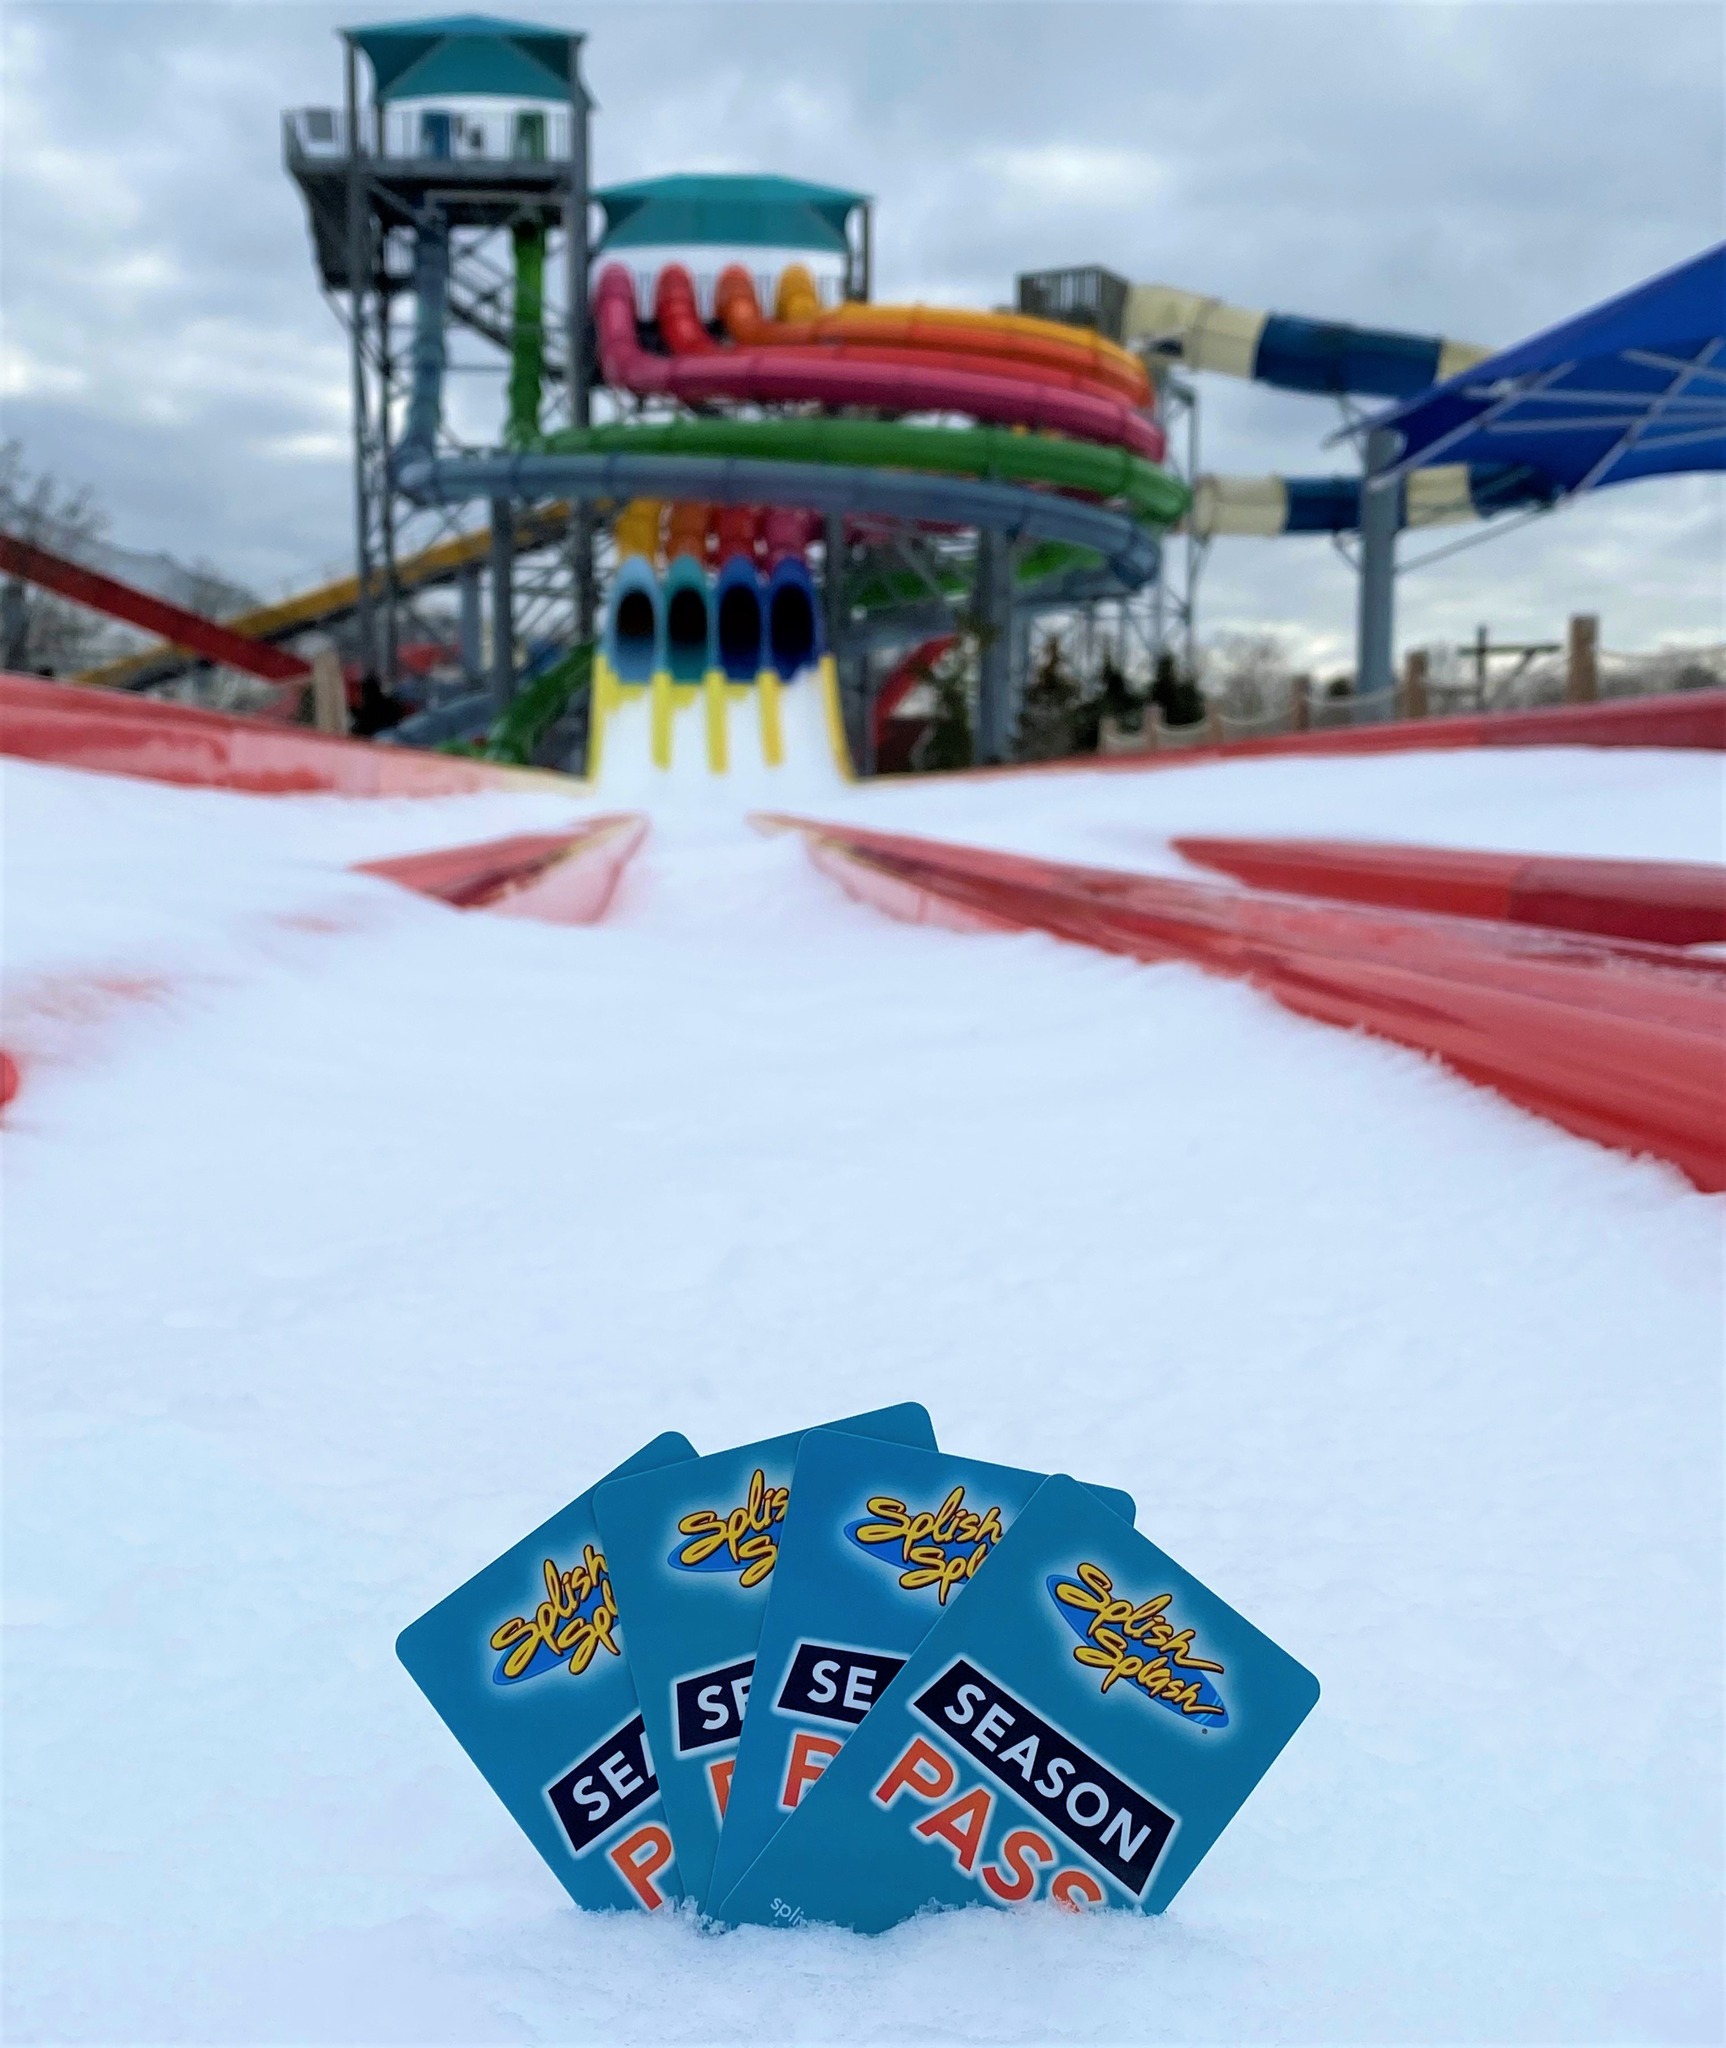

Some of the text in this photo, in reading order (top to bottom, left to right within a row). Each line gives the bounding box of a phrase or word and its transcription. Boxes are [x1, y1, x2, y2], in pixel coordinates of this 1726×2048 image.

[856, 1485, 1004, 1564] Splish
[490, 1544, 609, 1680] Splish
[1055, 1562, 1225, 1675] Splish
[806, 1660, 878, 1711] SE
[1073, 1627, 1225, 1716] Splash
[944, 1683, 1152, 1863] SEASON
